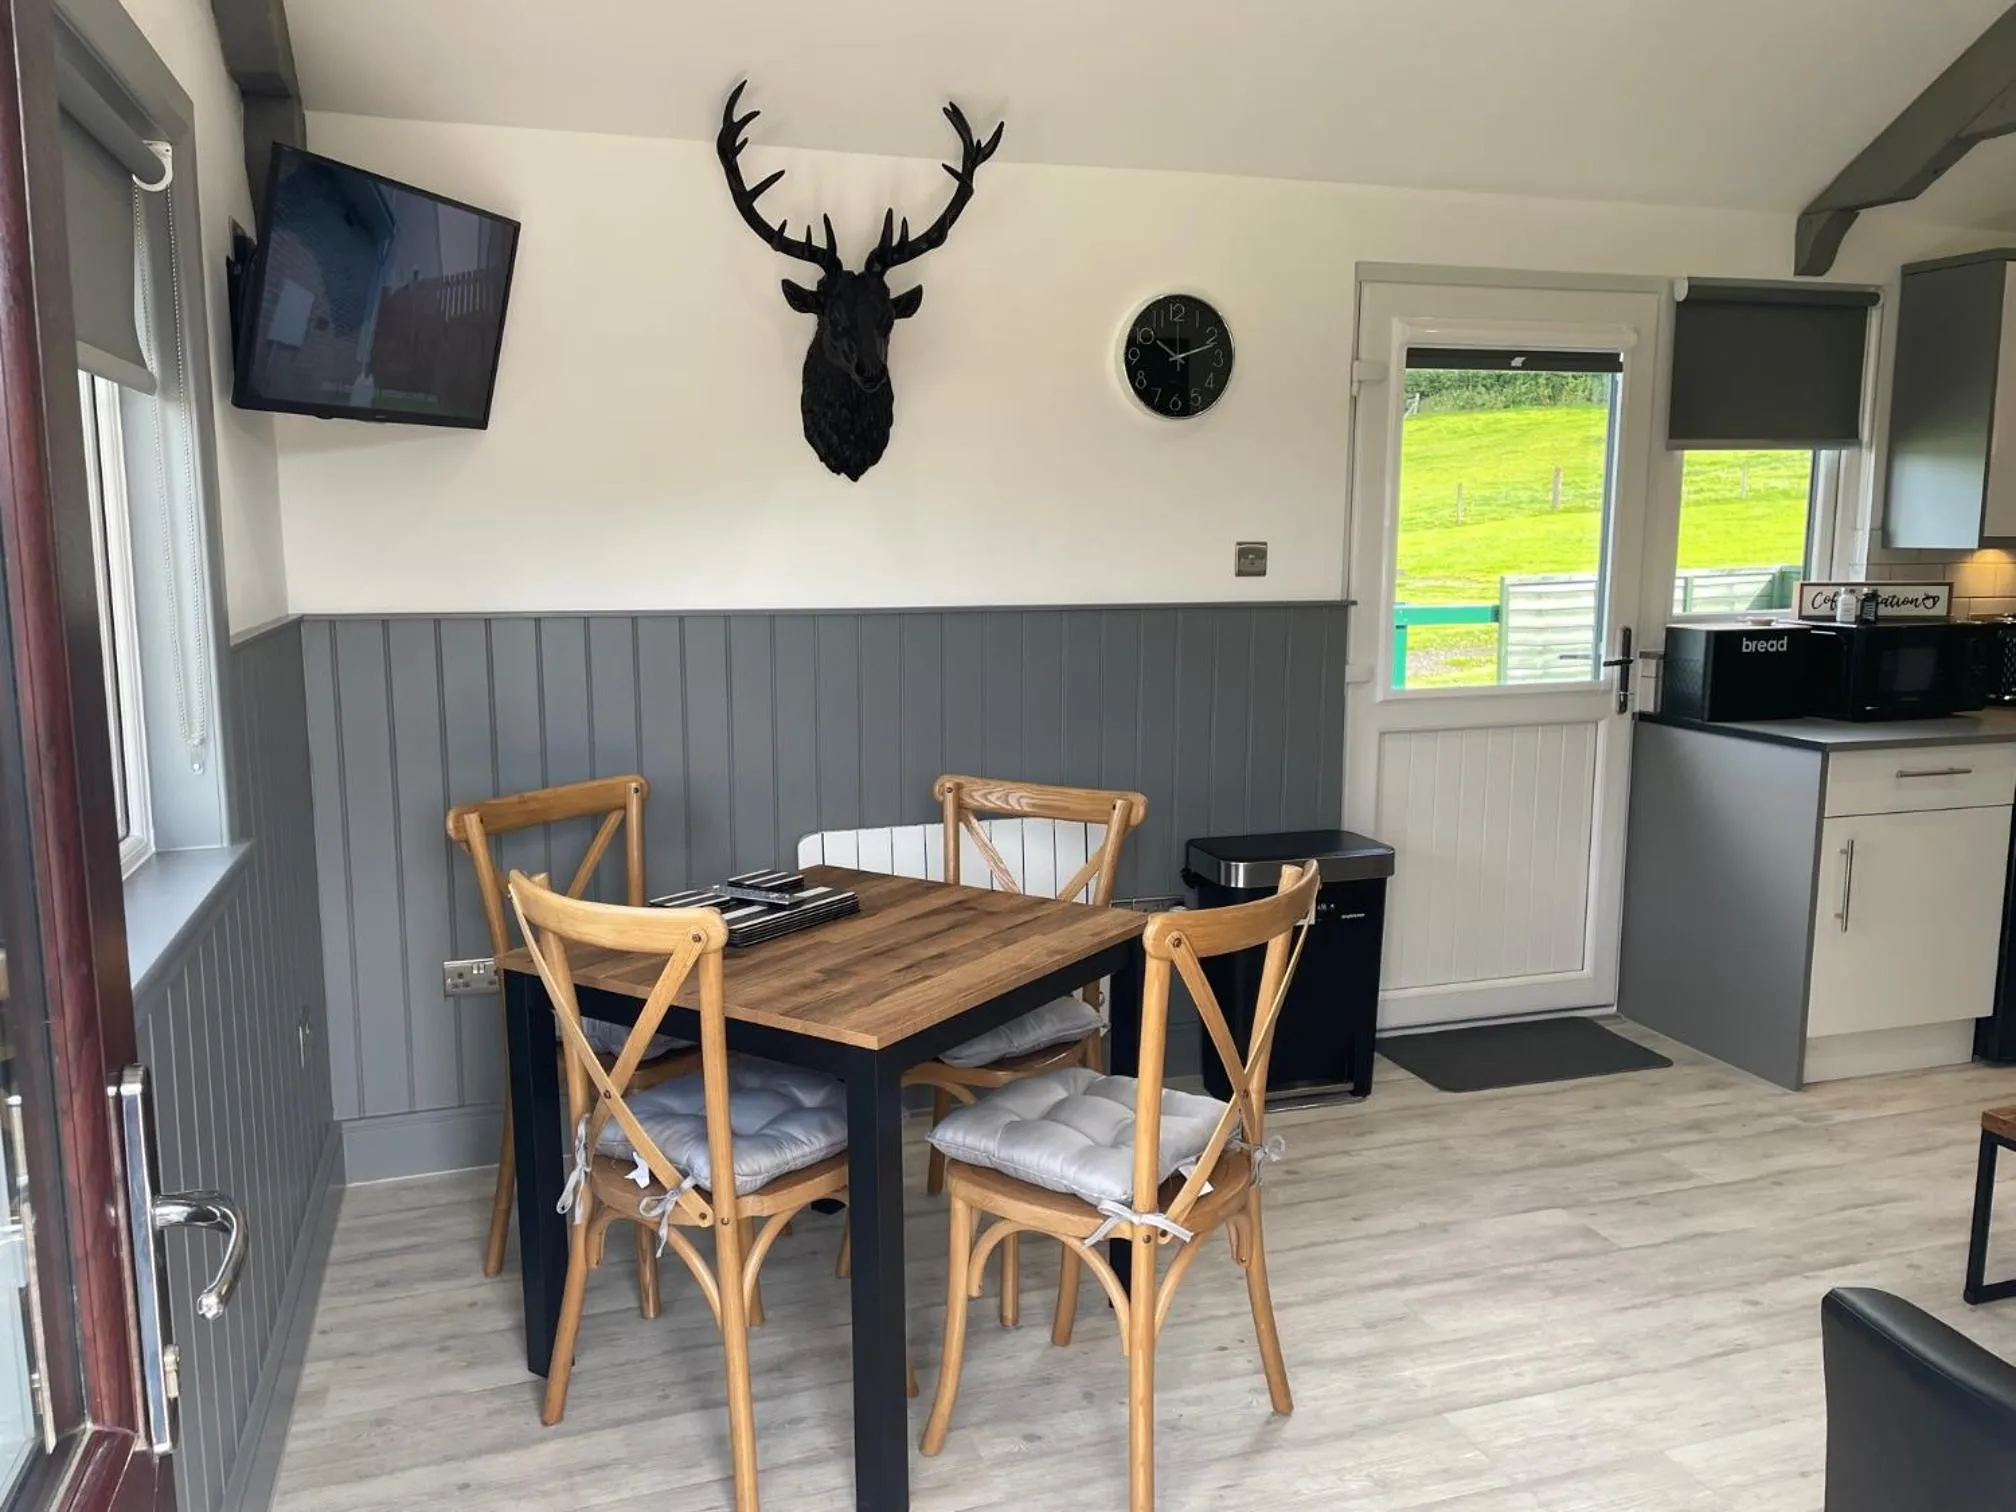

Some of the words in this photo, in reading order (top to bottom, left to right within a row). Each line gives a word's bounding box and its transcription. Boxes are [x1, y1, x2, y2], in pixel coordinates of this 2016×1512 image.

[1153, 310, 1164, 329] 11
[1169, 303, 1185, 321] 12
[1195, 310, 1199, 329] 1
[1136, 327, 1155, 345] 10
[1205, 326, 1218, 344] 2
[1128, 347, 1140, 366] 9
[1212, 349, 1224, 367] 3
[1135, 370, 1147, 389] 8
[1204, 372, 1215, 389] 4
[1150, 387, 1162, 405] 7
[1169, 393, 1182, 411] 6
[1190, 388, 1201, 406] 5
[1742, 635, 1788, 653] bread
